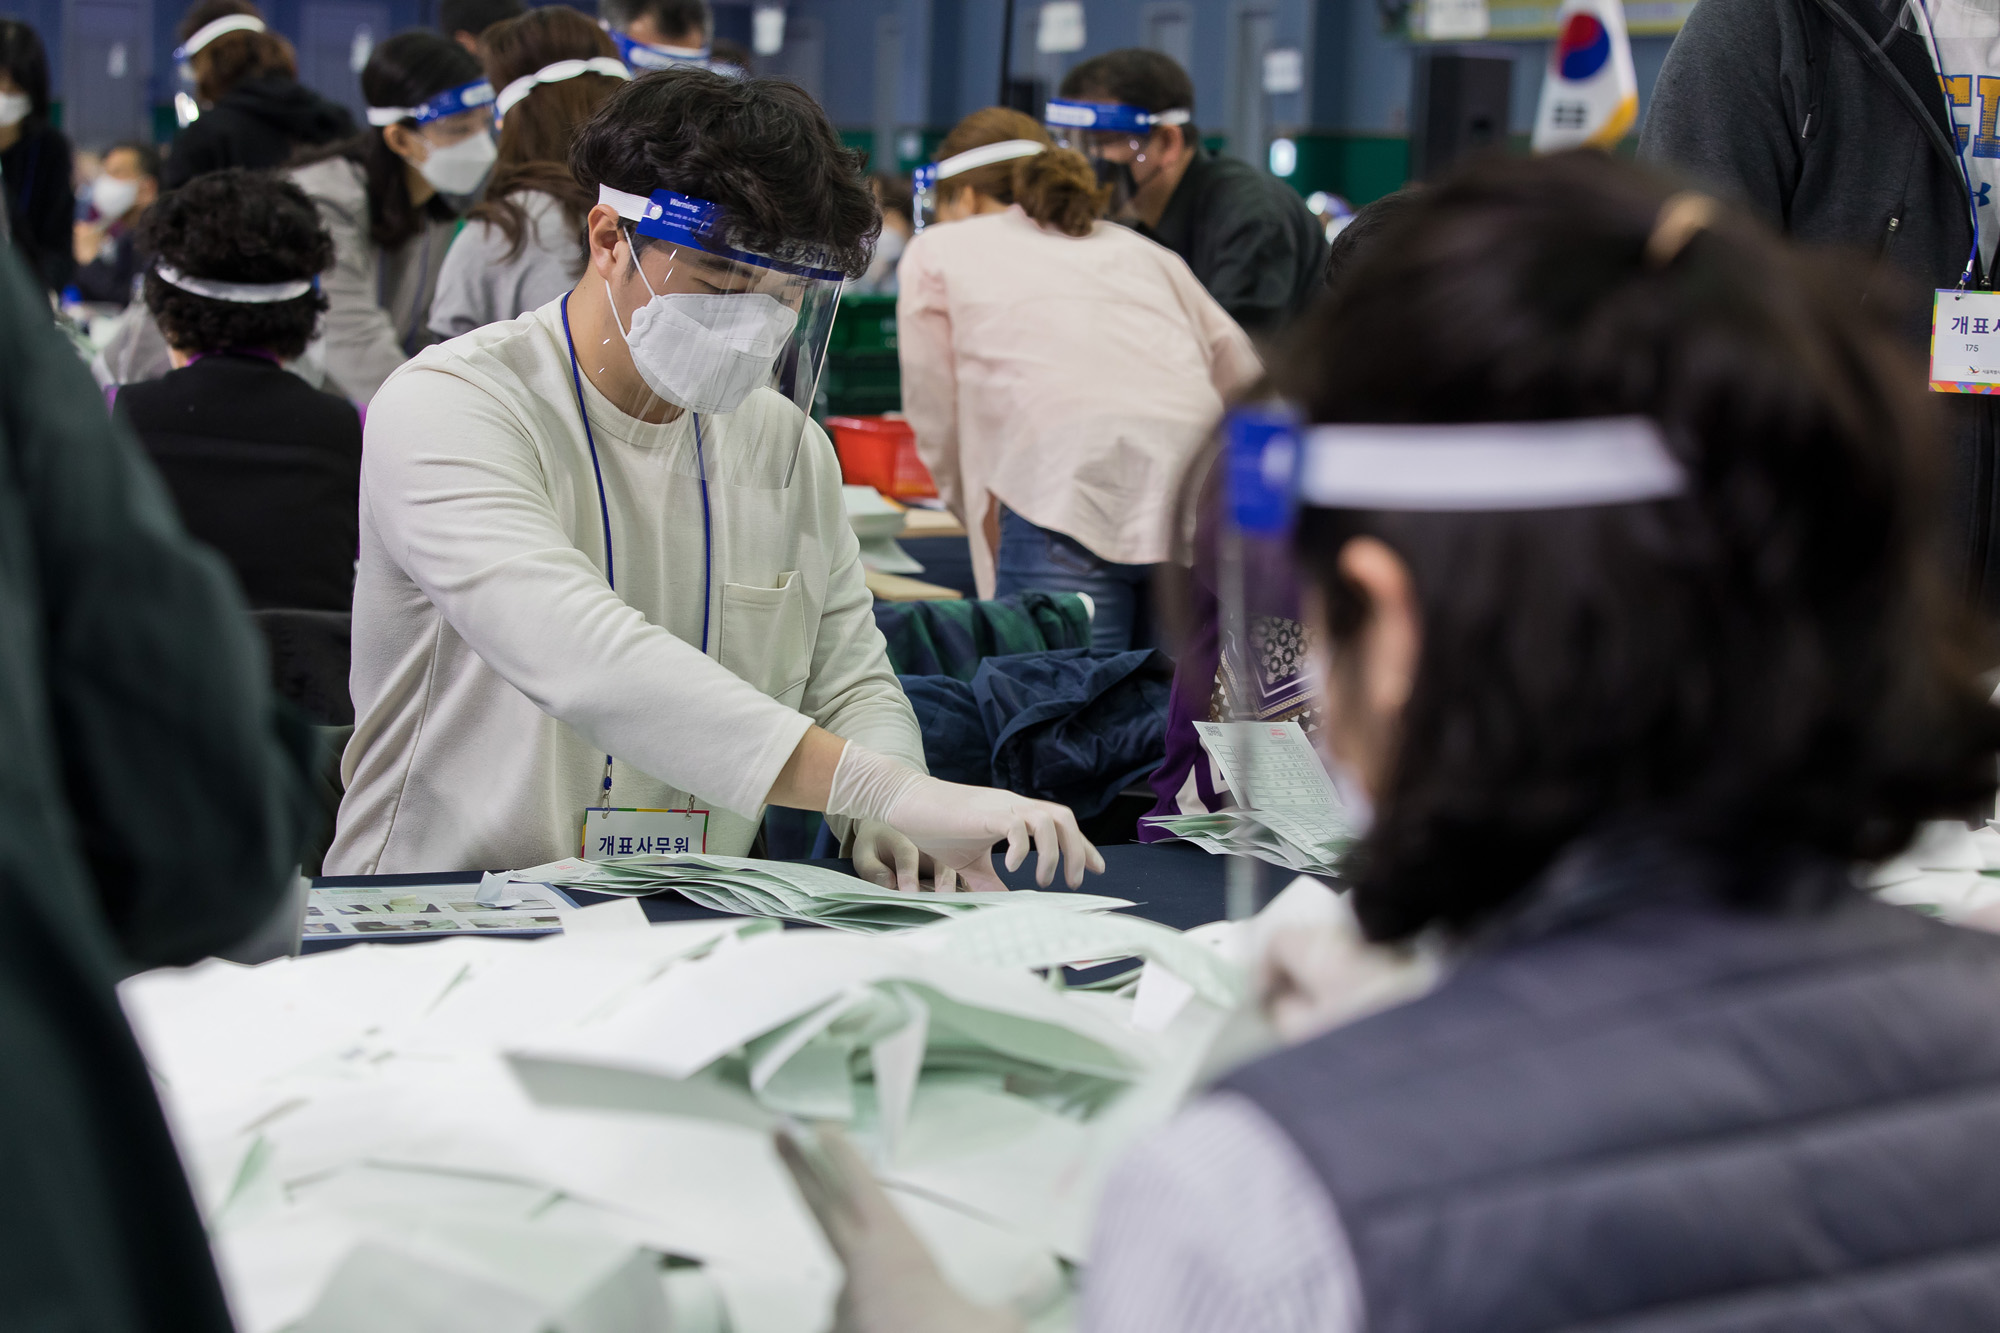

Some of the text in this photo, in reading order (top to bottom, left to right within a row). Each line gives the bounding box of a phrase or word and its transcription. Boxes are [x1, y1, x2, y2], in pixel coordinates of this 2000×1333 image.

[669, 197, 701, 213] Warning:
[1965, 343, 1979, 352] 175
[598, 835, 689, 856] 개표사무원
